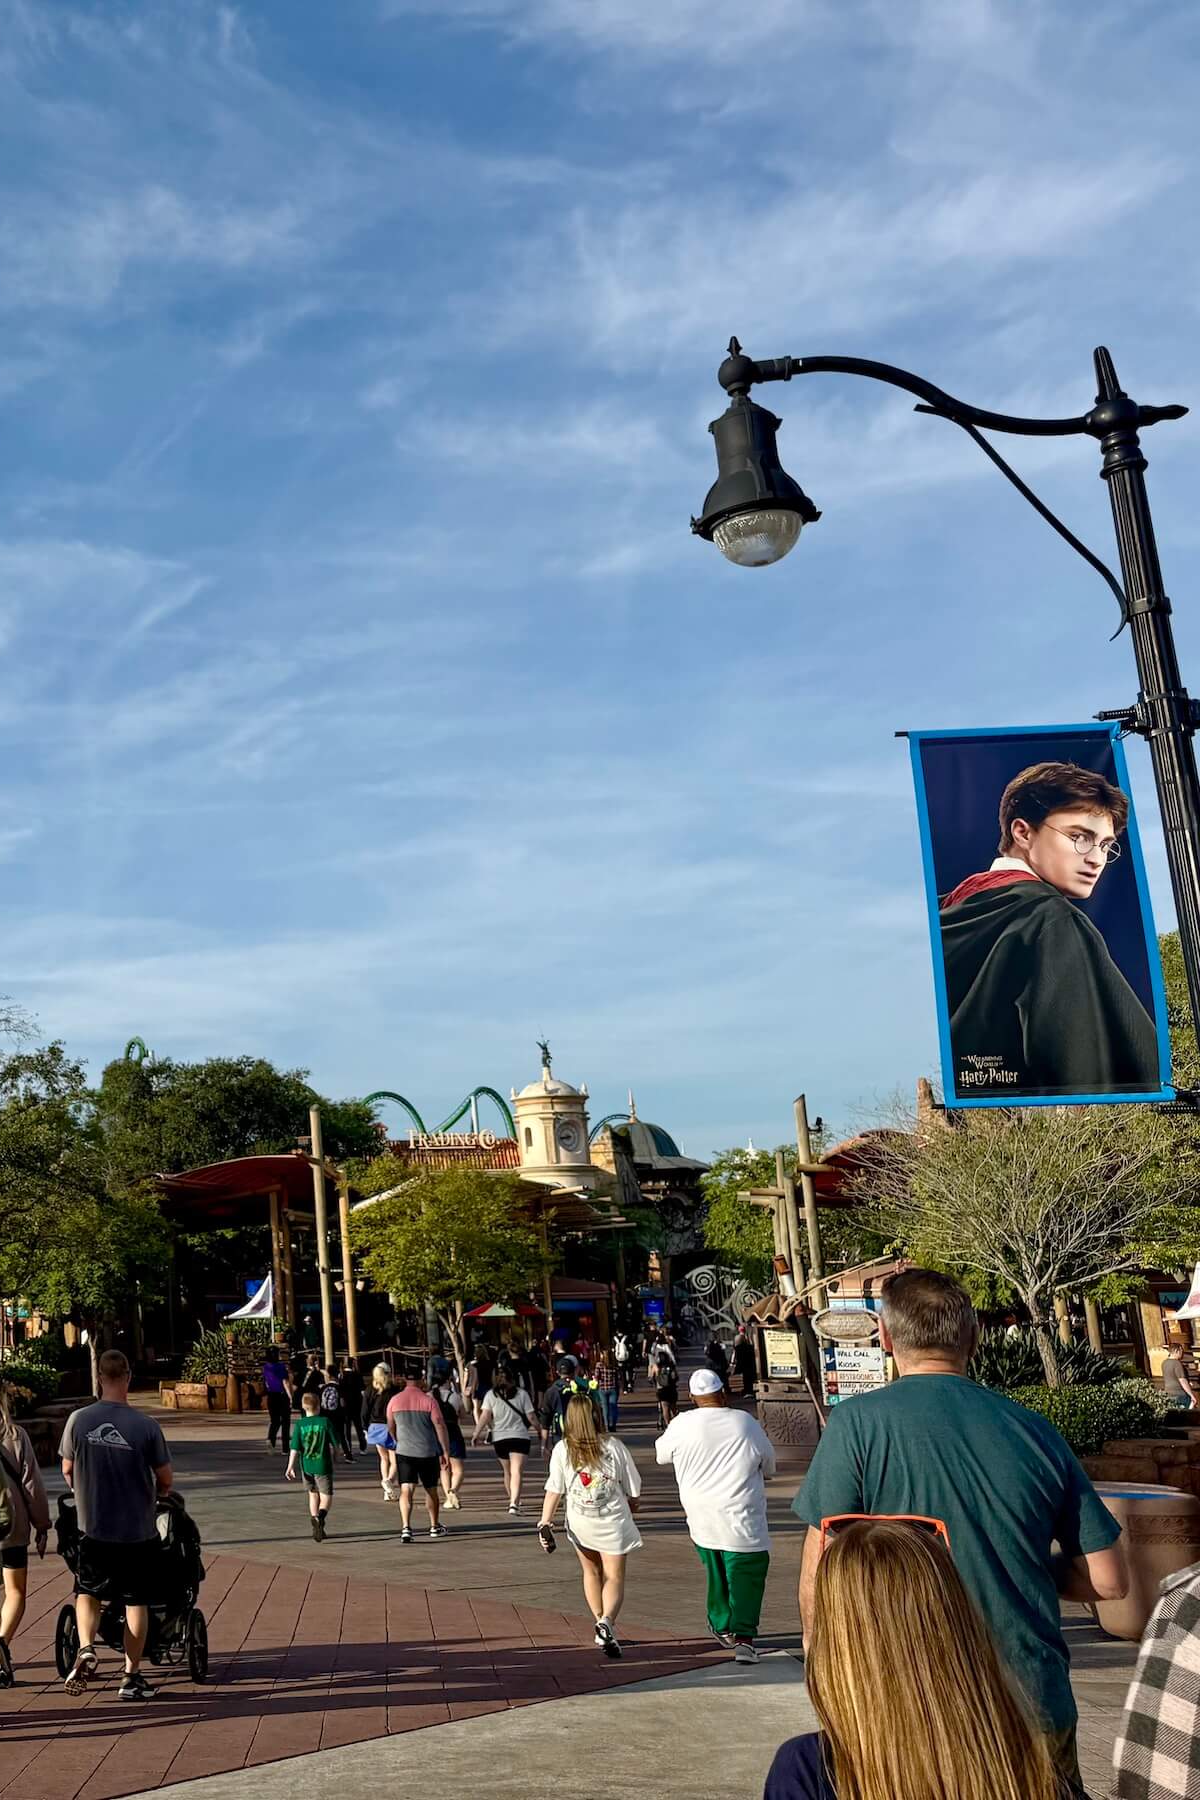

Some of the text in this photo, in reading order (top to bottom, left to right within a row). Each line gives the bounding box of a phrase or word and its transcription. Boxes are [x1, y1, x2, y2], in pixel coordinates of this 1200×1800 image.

[960, 1068, 1019, 1088] Harry Potter
[406, 1129, 477, 1149] TRADING
